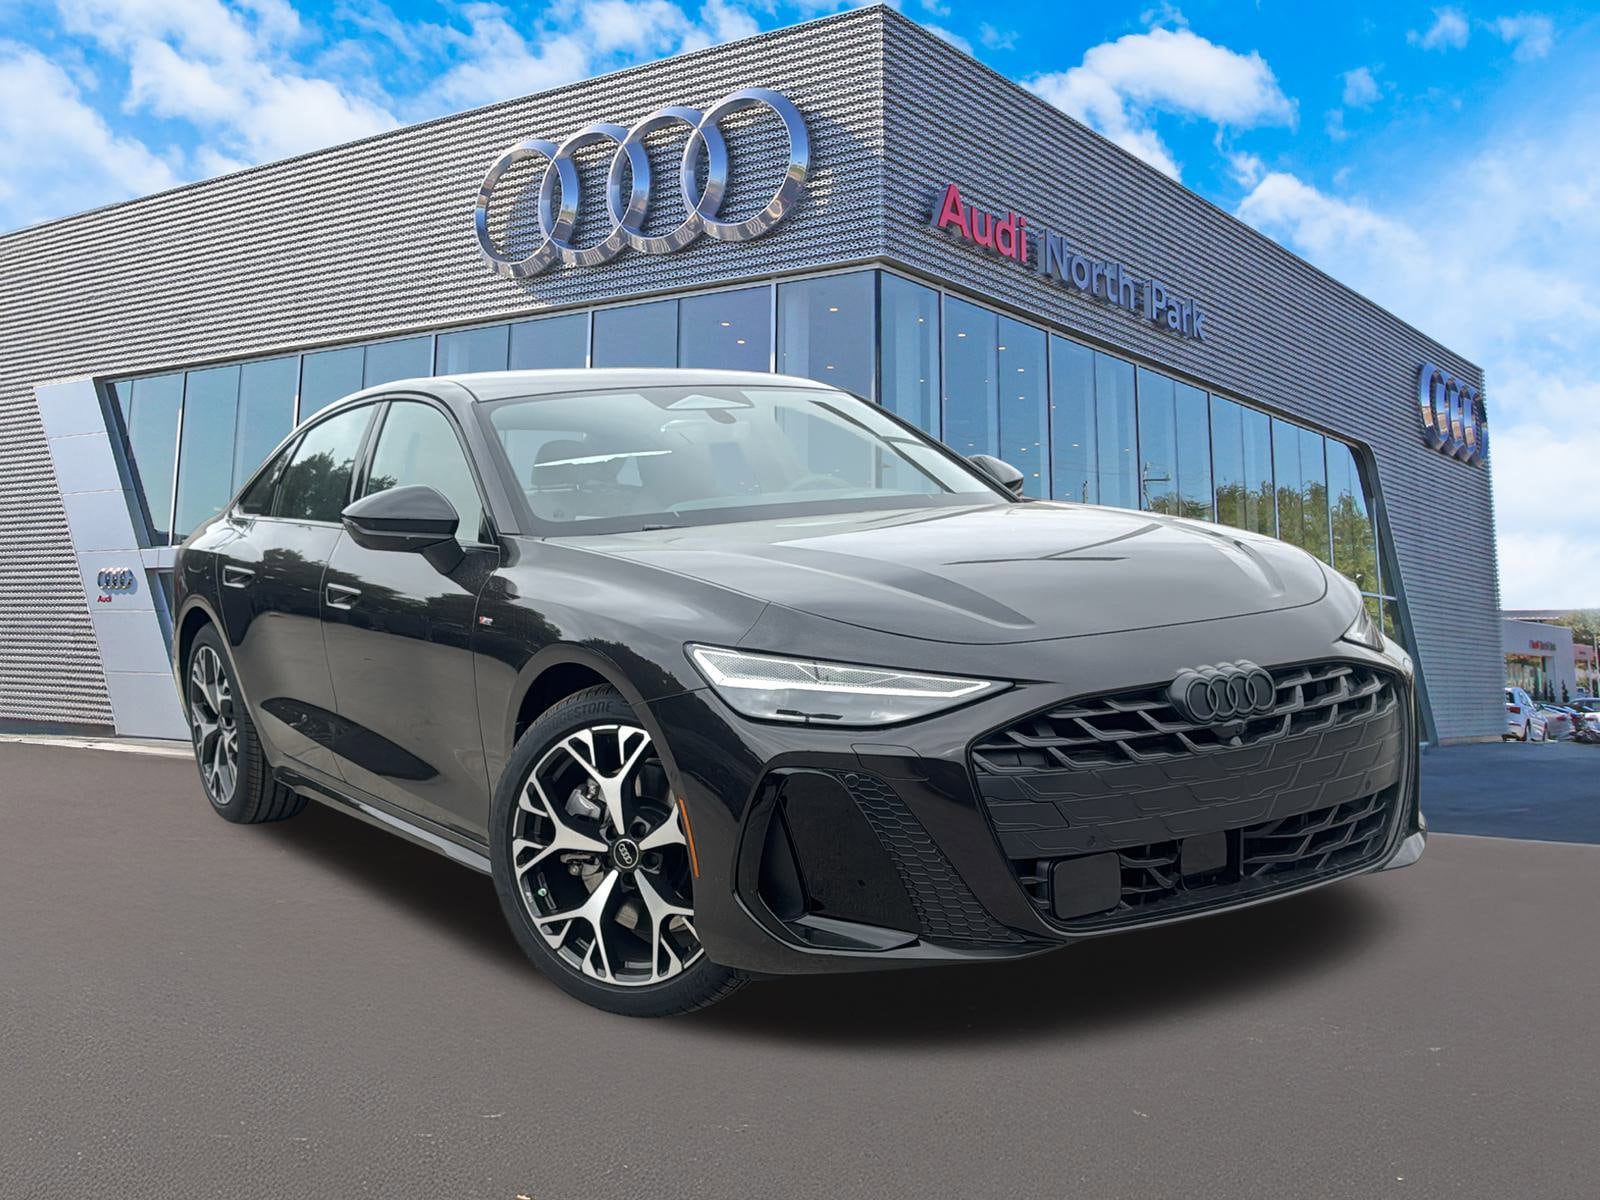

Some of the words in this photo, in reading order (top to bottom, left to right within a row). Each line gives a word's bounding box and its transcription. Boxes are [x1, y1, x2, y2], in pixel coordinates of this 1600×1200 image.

[936, 183, 1027, 263] Audi
[1040, 229, 1137, 311] North
[1146, 278, 1206, 341] Park
